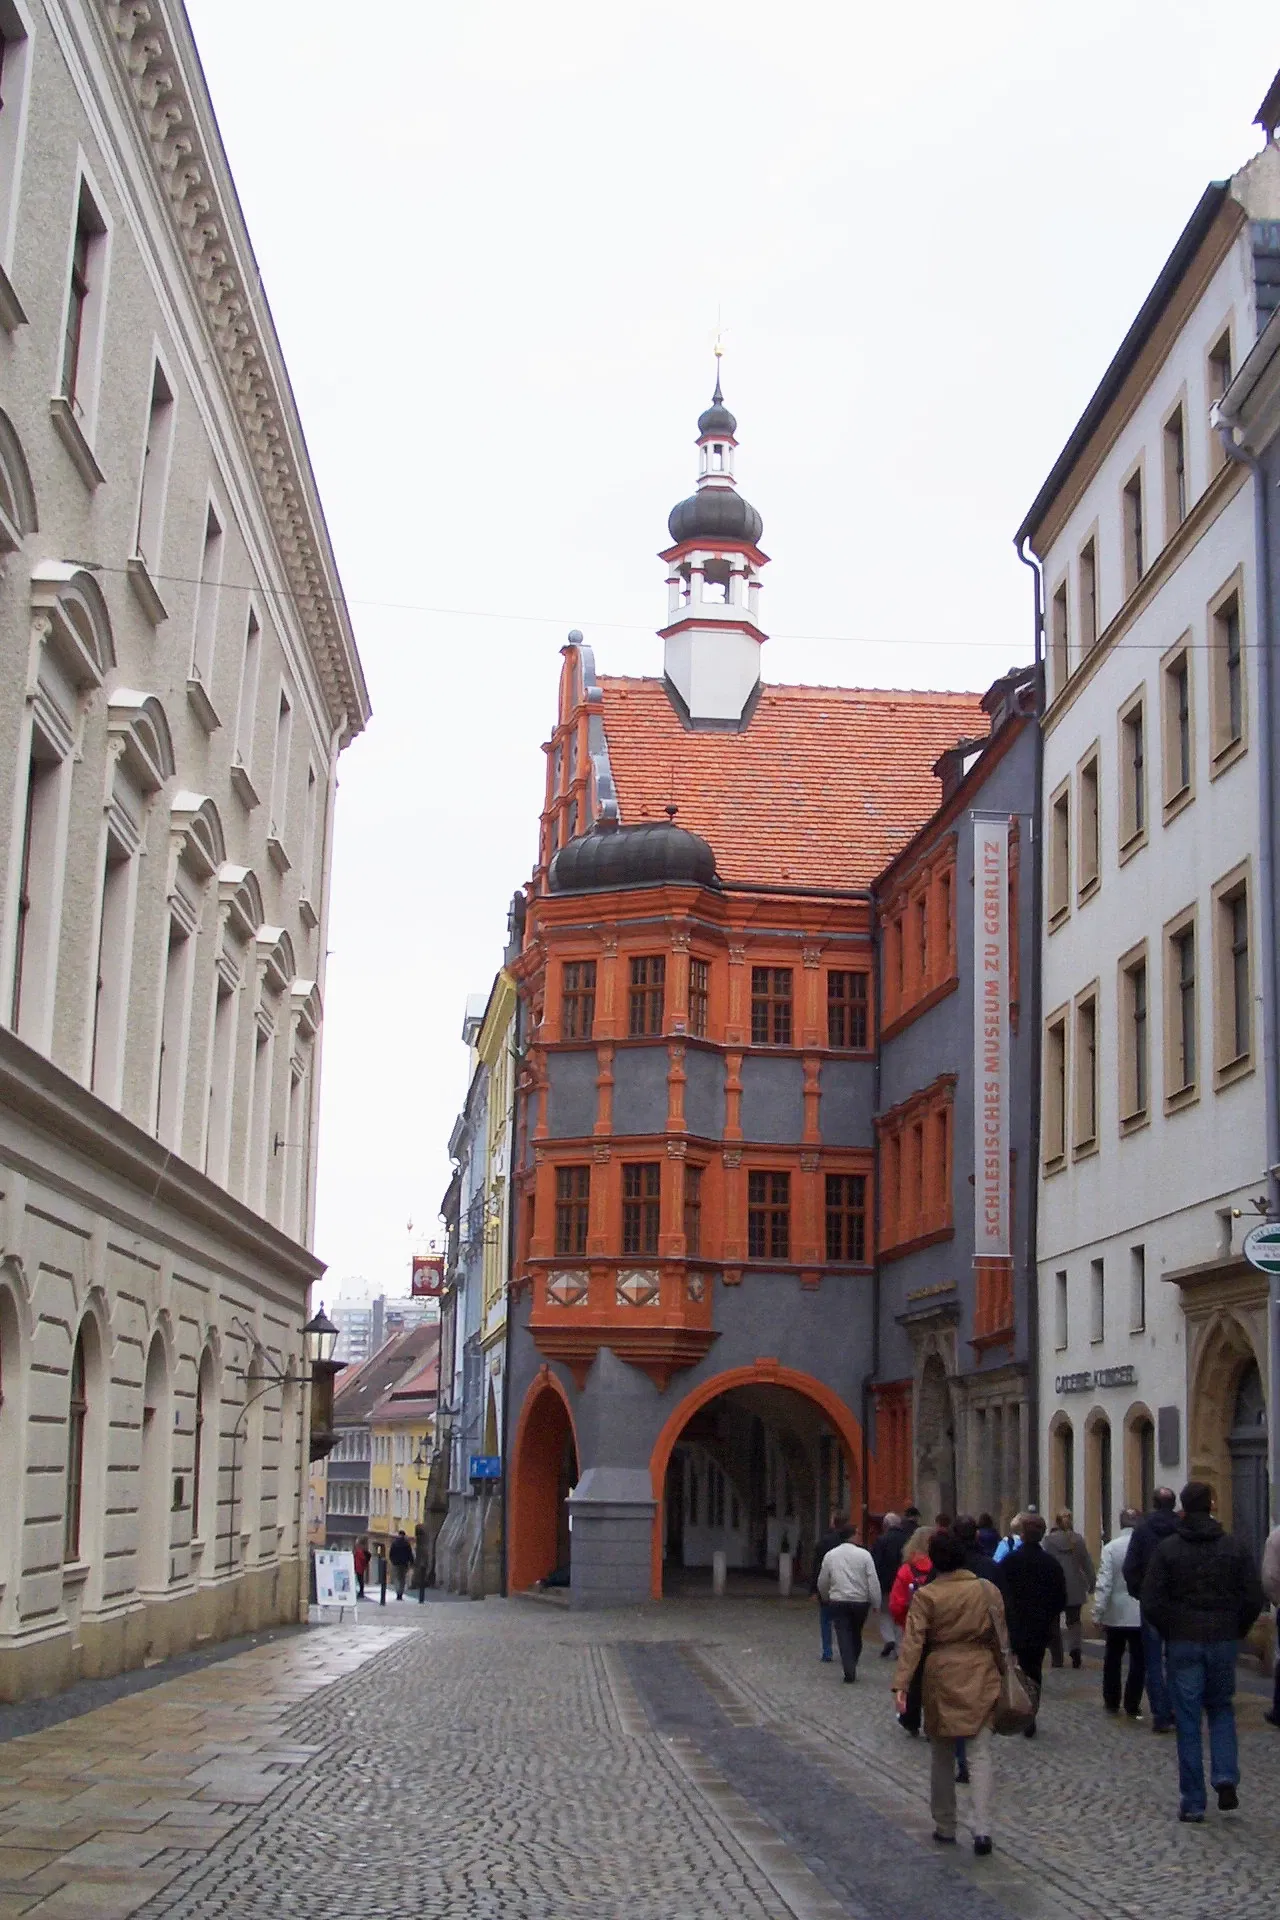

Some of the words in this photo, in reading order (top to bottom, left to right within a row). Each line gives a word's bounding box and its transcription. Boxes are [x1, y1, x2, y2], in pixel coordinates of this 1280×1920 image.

[984, 943, 1000, 972] ZU
[984, 979, 1000, 1073] MUSEUM
[984, 1081, 1001, 1237] SCHLESISCHES
